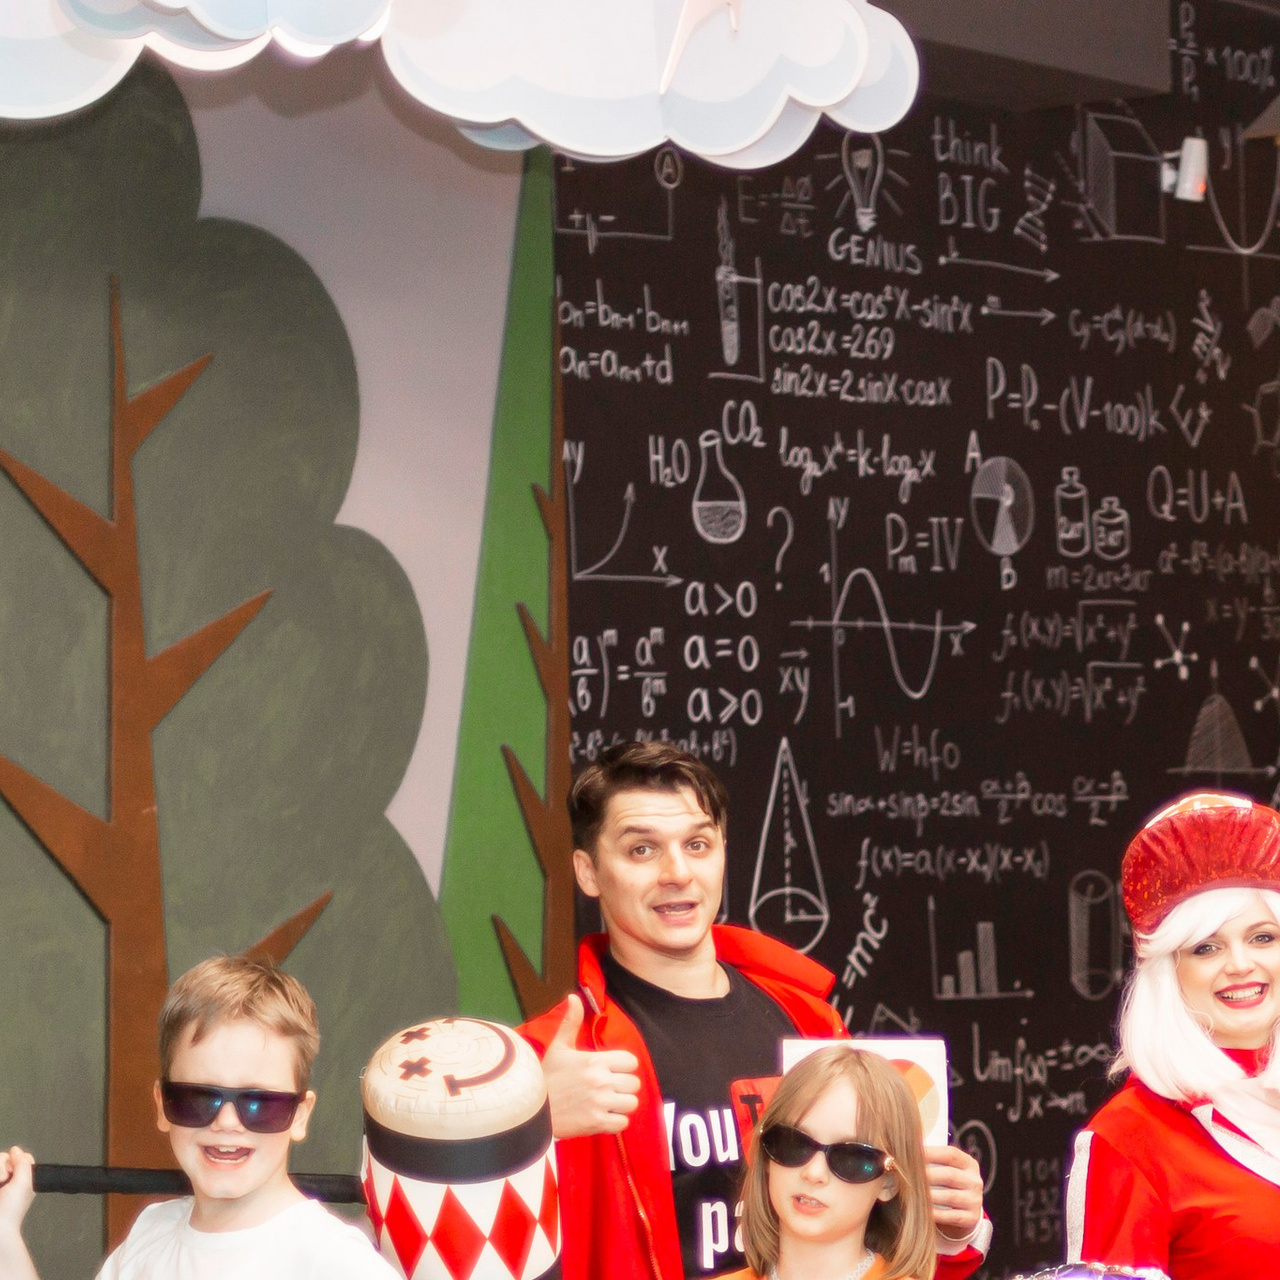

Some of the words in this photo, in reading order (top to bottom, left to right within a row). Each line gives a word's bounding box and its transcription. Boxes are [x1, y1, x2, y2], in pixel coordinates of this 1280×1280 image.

[931, 115, 1009, 174] think
[937, 173, 1001, 234] BIG
[827, 226, 924, 275] GENIUS
